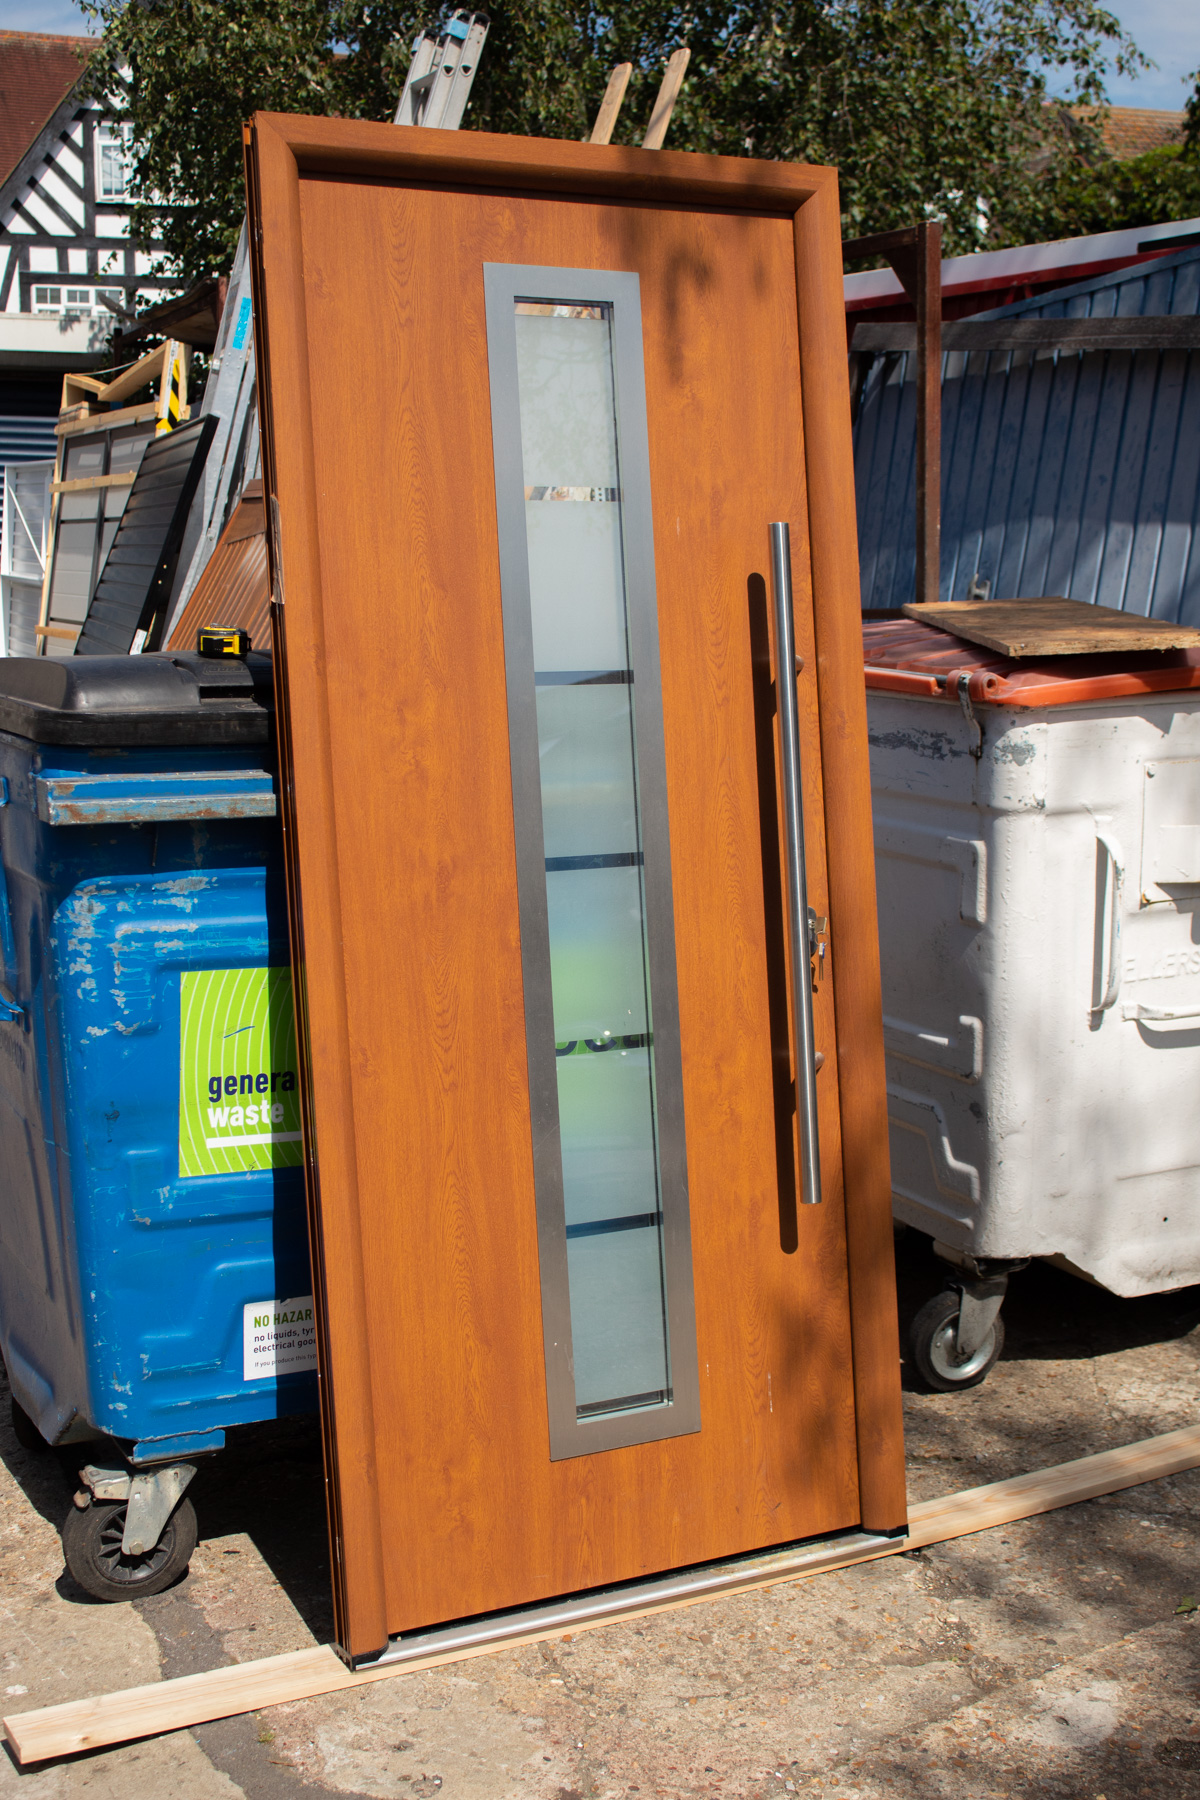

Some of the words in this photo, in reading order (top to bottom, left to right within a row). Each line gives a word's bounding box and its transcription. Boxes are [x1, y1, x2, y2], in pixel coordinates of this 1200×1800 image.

[208, 1069, 298, 1103] genera
[207, 1099, 284, 1128] waste
[254, 1315, 270, 1328] NO
[273, 1308, 312, 1326] HAZAR
[254, 1334, 265, 1342] no
[267, 1329, 300, 1341] liquids,
[302, 1327, 315, 1337] tyr
[253, 1339, 295, 1353] electrical
[260, 1360, 270, 1368] you
[271, 1356, 294, 1366] produce
